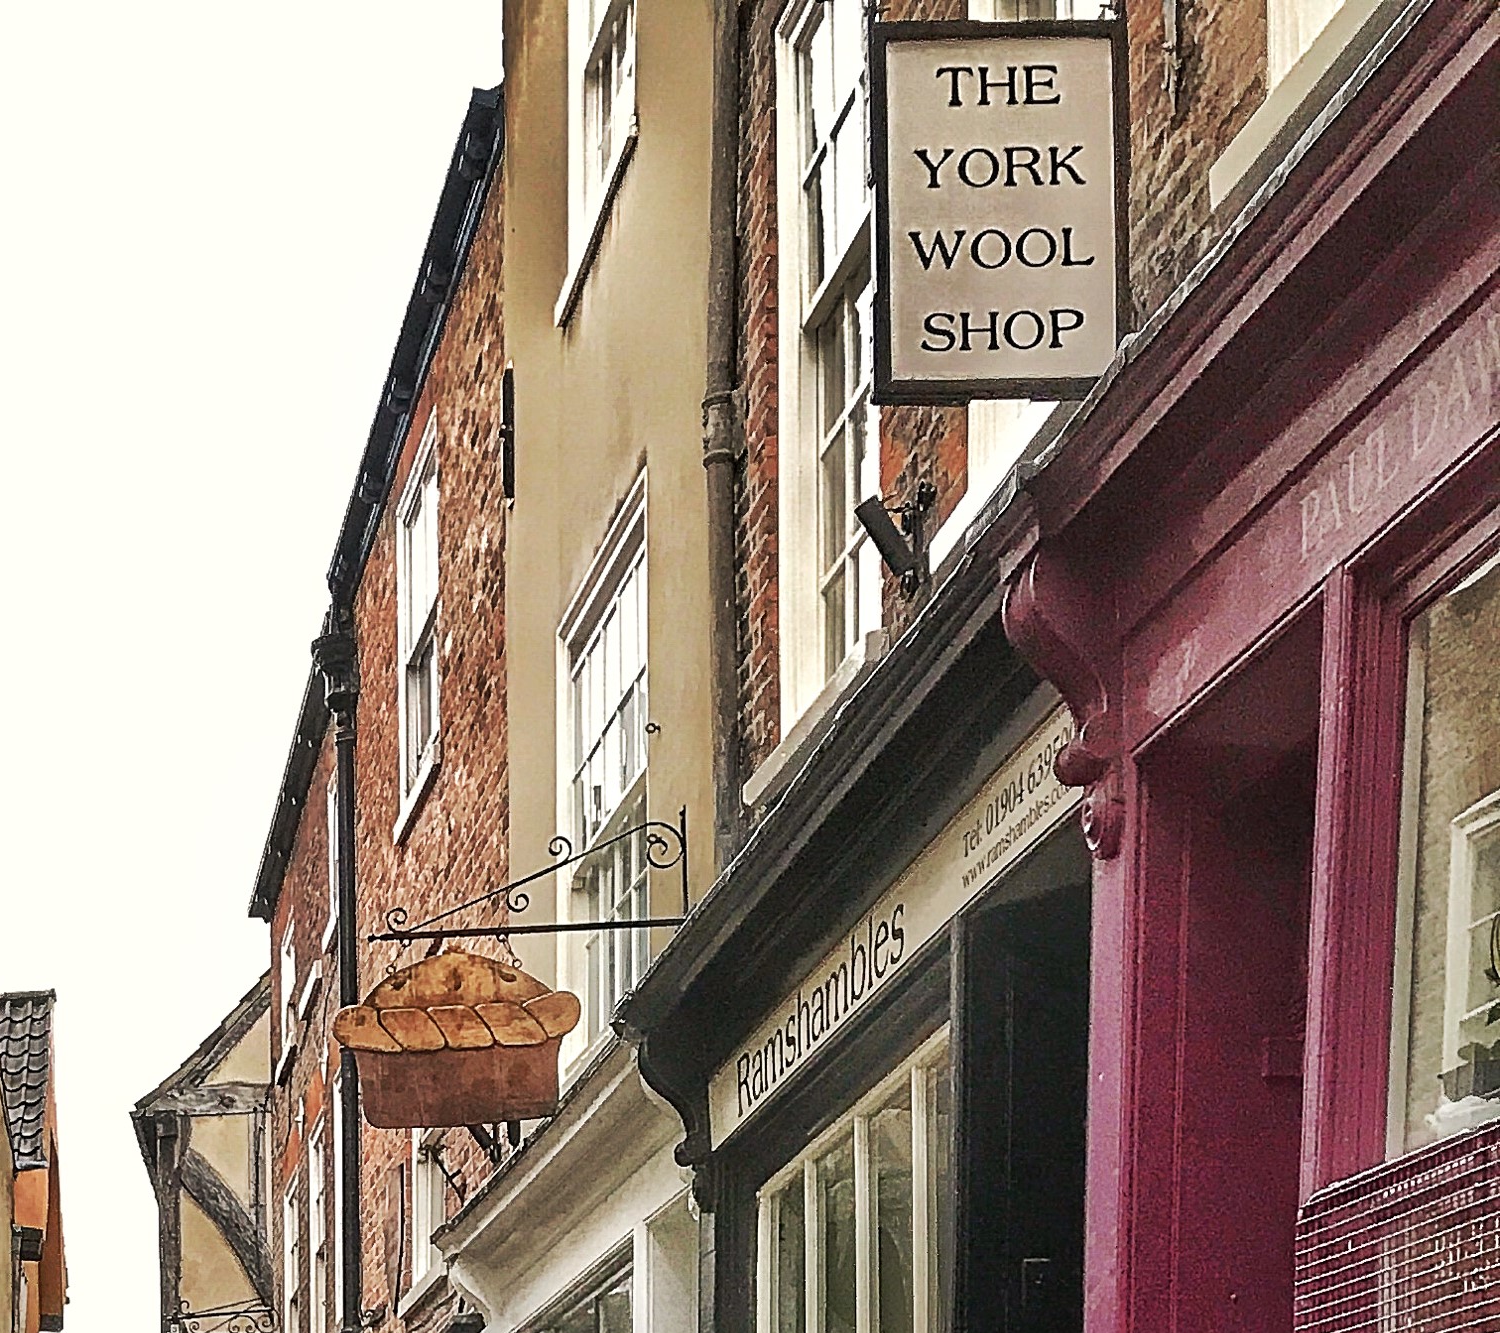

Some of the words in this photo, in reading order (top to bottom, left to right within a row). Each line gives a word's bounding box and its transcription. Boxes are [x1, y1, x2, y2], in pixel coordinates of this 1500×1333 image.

[936, 64, 1061, 107] THE
[914, 144, 1087, 189] YORK
[907, 226, 1096, 271] WOOL
[920, 308, 1086, 352] SHOP
[985, 771, 1025, 835] 01904
[736, 903, 905, 1118] Ramshambles
